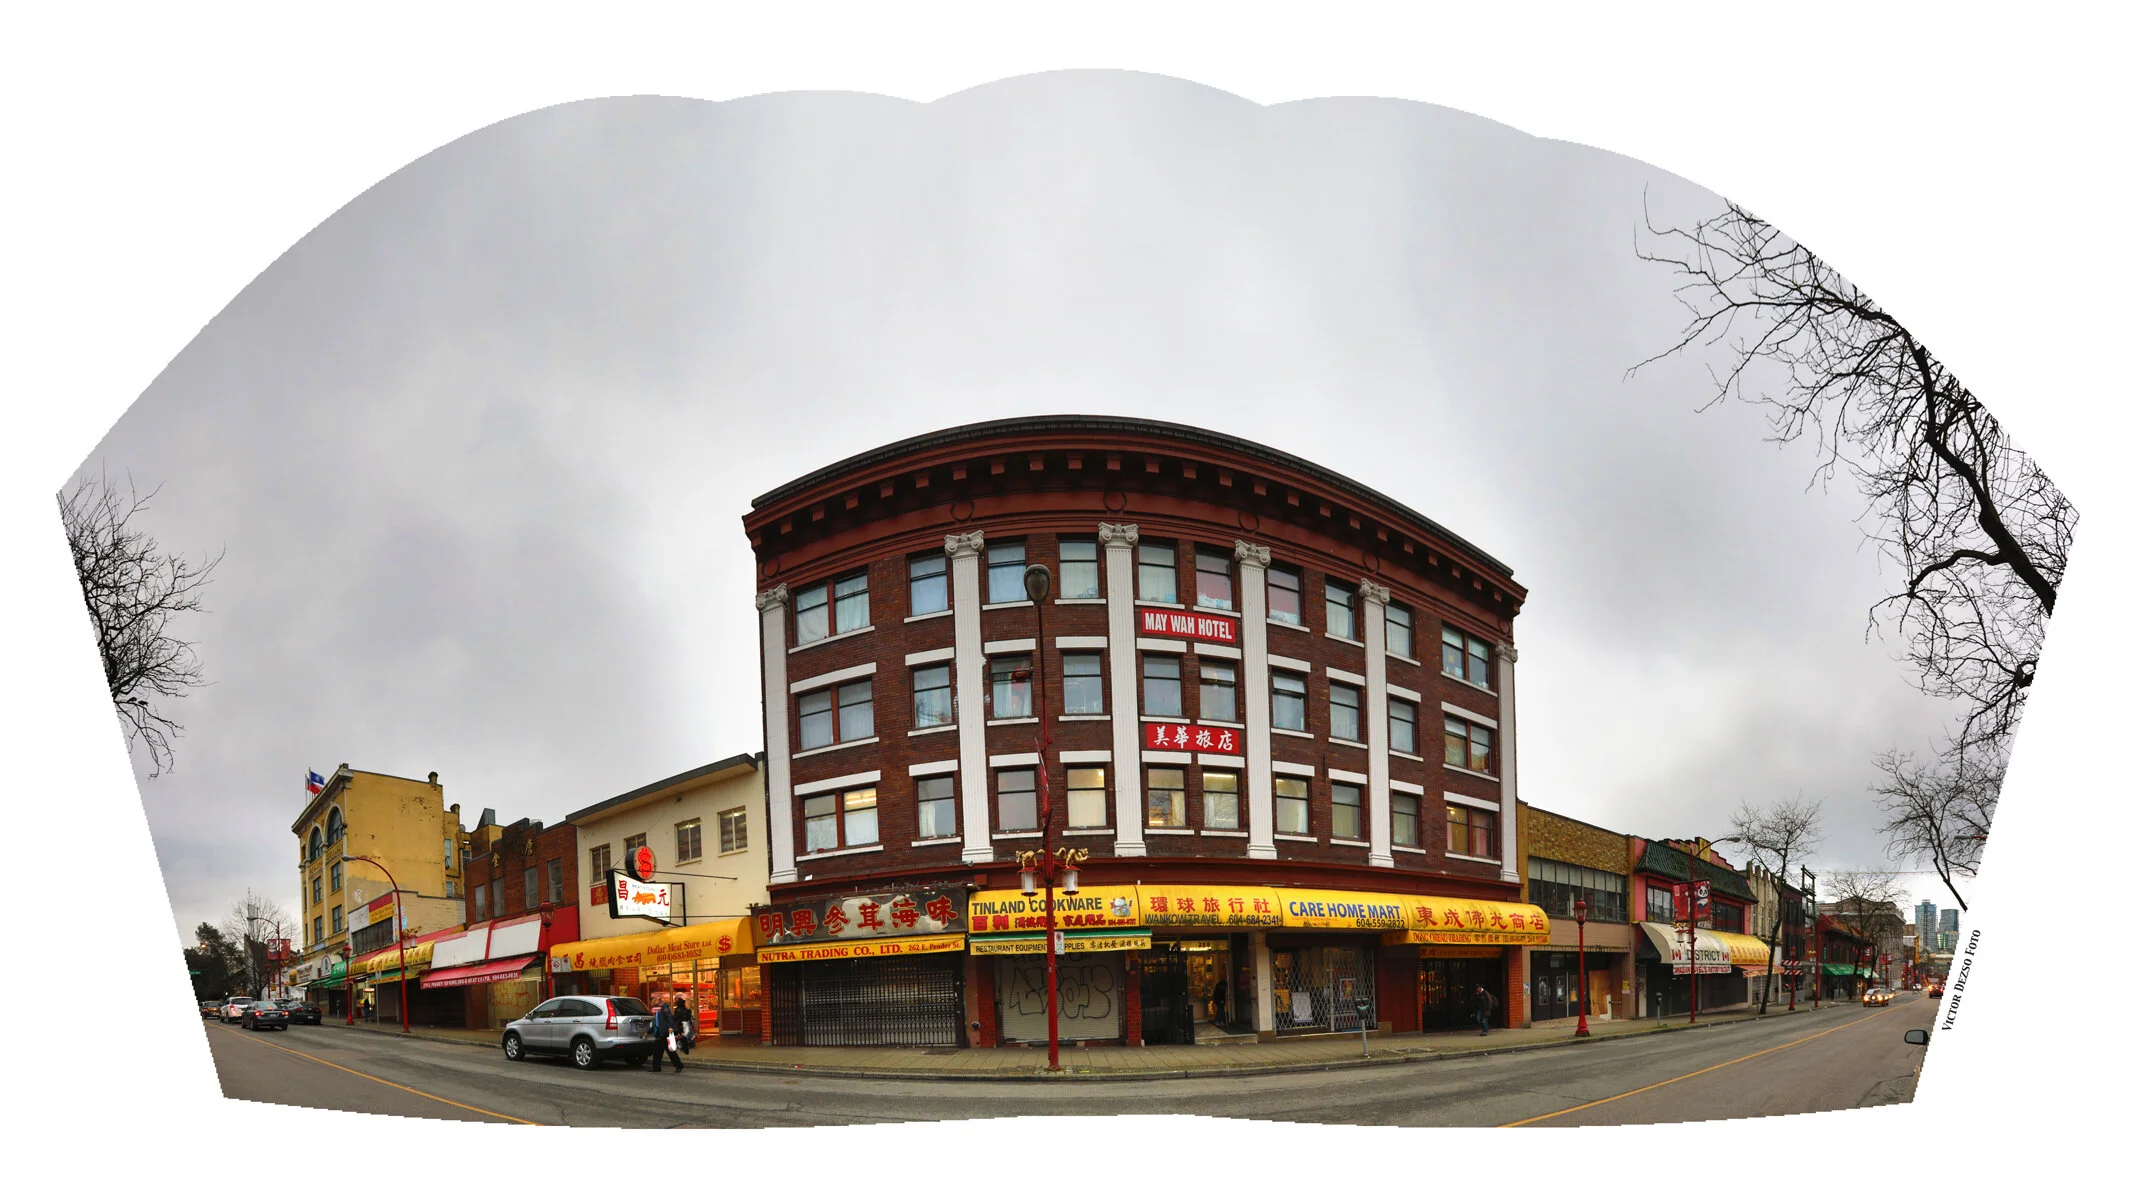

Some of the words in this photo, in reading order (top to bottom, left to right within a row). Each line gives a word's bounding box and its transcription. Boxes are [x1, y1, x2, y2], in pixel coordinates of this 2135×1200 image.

[1145, 612, 1167, 631] MAY
[1170, 615, 1195, 634] WAH
[1198, 618, 1232, 639] HOTEL
[1153, 725, 1233, 750] 美華旅店
[972, 901, 1025, 915] TINLAND
[1150, 896, 1272, 914] 環球旅行社
[1289, 901, 1326, 917] CARE
[1327, 903, 1366, 918] HOME
[1367, 905, 1400, 919] MART
[1144, 913, 1188, 925] WANKOW
[1189, 914, 1222, 925] TRAVEL
[1228, 914, 1280, 926] 604-684-2341
[1356, 918, 1405, 929] 604-559-2822
[647, 944, 666, 955] Dollar
[668, 943, 682, 952] Meat
[684, 941, 700, 950] Store
[761, 950, 796, 962] NUTRA
[800, 947, 849, 960] TRADING
[880, 944, 903, 955] LTD.
[929, 942, 950, 950] Pender
[975, 944, 1015, 952] RESTAURANT
[1686, 949, 1720, 961] DSTRICT
